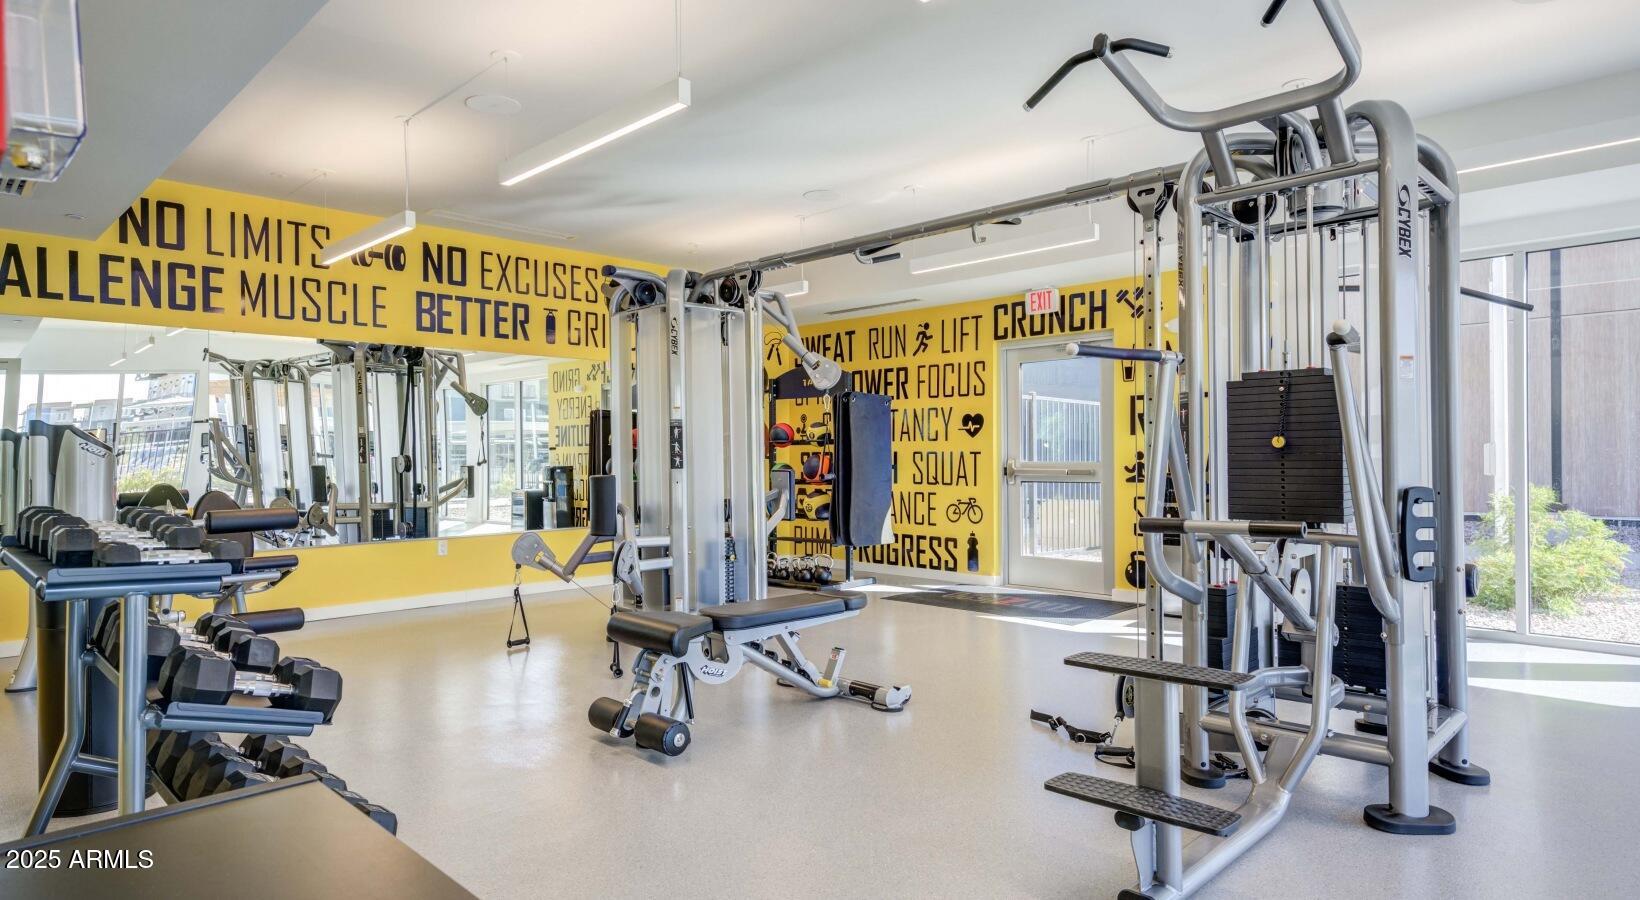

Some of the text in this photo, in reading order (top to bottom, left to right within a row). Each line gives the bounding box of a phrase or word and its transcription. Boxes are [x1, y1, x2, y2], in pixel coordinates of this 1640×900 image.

[119, 197, 598, 304] NO LIMITS NO EXCUSES
[1398, 206, 1412, 259] CYBEX
[240, 269, 387, 329] MUSCLE
[415, 290, 530, 342] BETTER
[567, 308, 606, 349] GRI
[1030, 290, 1052, 312] EXIT
[670, 328, 679, 356] CYBEX
[795, 288, 1107, 368] WEAT RUN LIFT CRUNCH
[851, 360, 986, 401] OWER FOCUS
[890, 406, 953, 442] TANCY
[913, 451, 981, 487] SQUAT
[890, 490, 937, 527] ANCE
[856, 532, 958, 573] ROGRESS
